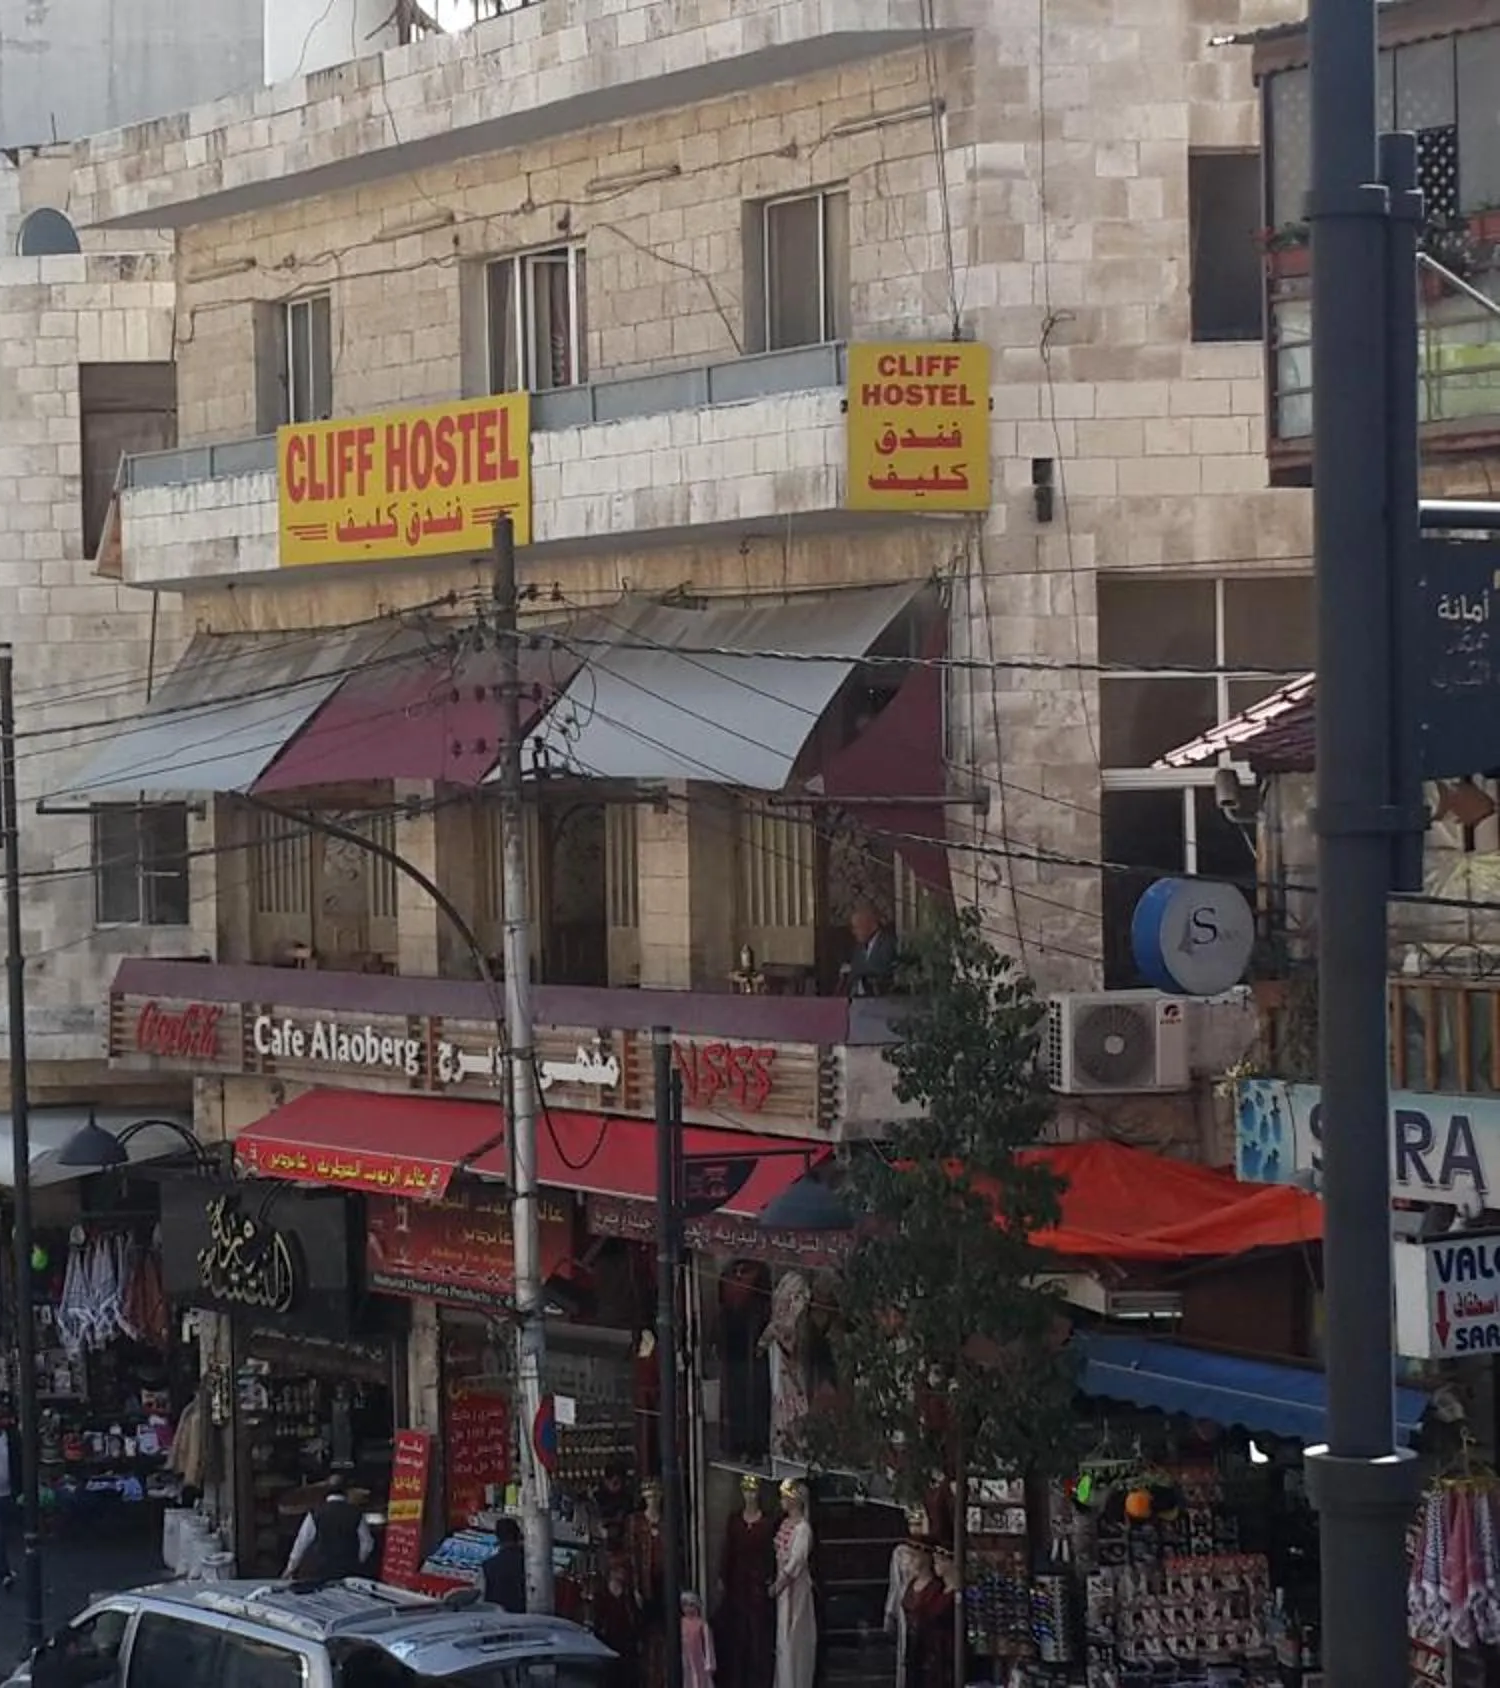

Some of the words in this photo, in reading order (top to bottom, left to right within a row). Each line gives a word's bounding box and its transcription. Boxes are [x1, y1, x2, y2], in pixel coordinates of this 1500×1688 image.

[877, 355, 960, 376] CLIFF
[861, 383, 975, 406] HOSTEL
[286, 427, 375, 504] CLIFF
[385, 407, 519, 494] HOSTEL
[874, 421, 963, 455] فندق
[867, 462, 969, 497] كليف
[336, 502, 399, 549] كليف
[406, 497, 464, 546] فندق
[1437, 588, 1490, 624] أمانة
[254, 1014, 304, 1057] Cafe
[311, 1020, 420, 1075] Alaoberg
